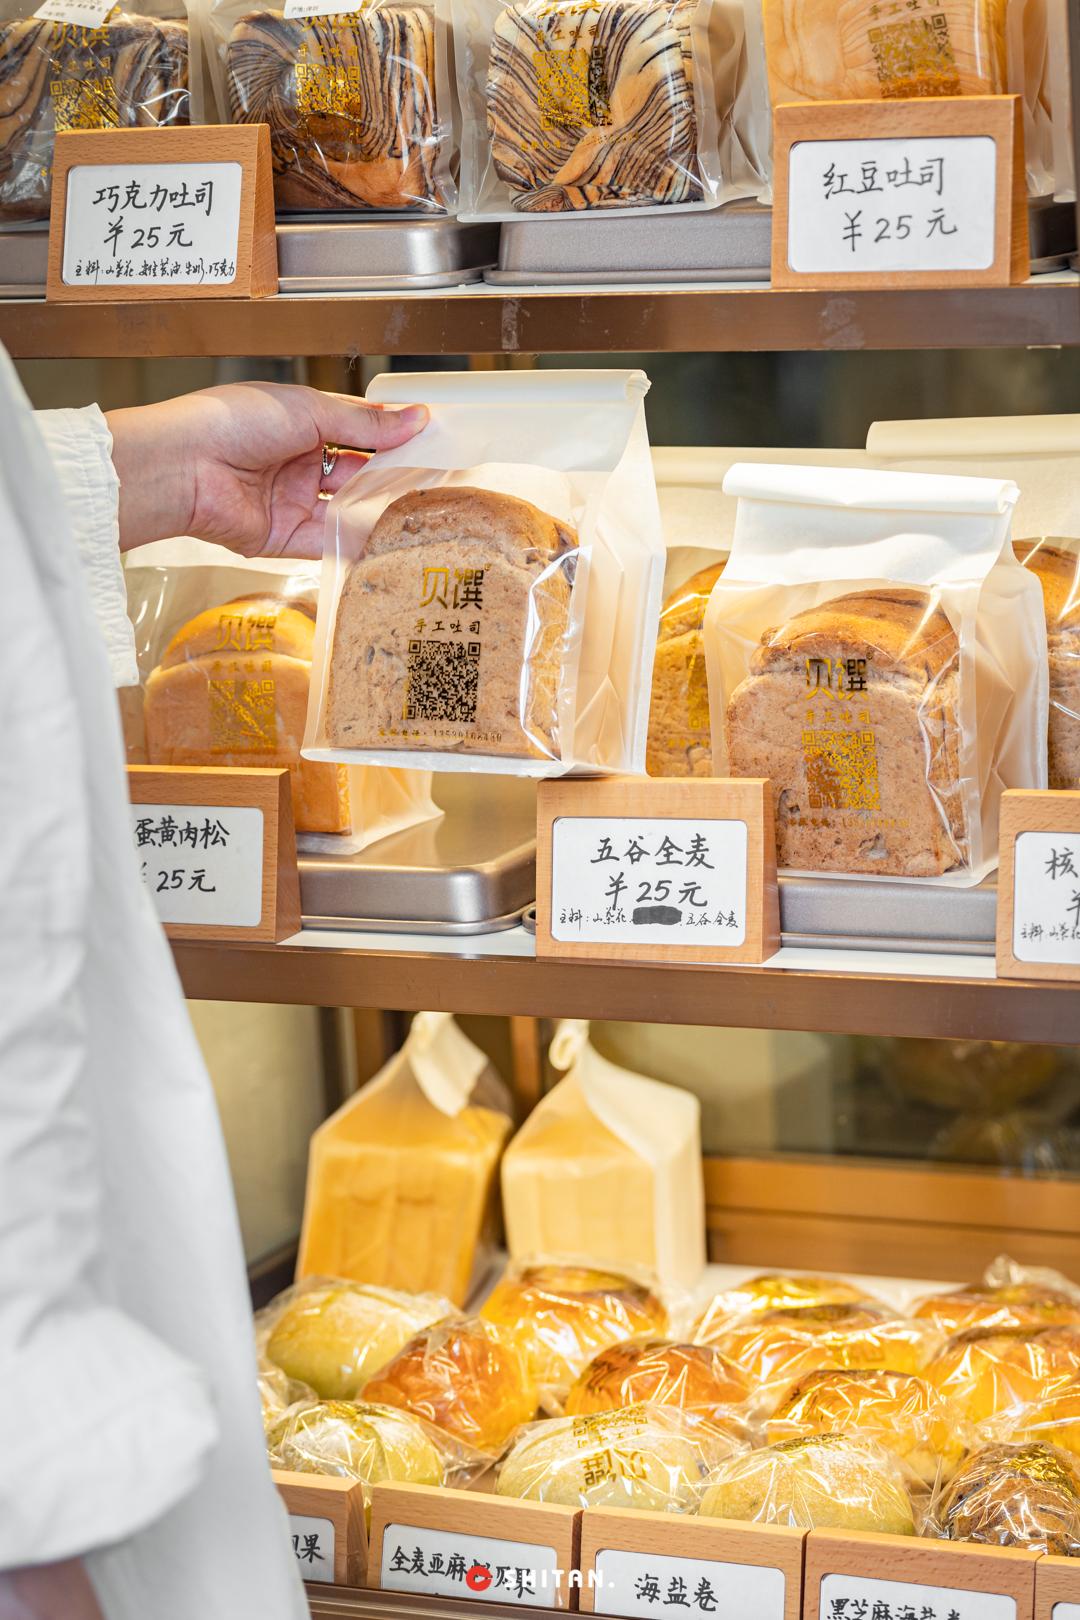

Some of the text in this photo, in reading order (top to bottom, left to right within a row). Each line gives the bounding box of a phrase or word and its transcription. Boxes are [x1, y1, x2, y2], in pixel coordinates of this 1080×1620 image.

[822, 157, 945, 200] 红豆吐司
[93, 180, 214, 217] 巧克力吐司
[413, 618, 481, 636] 手工吐司
[134, 815, 231, 850] 蛋黄肉松
[589, 833, 716, 870] 五谷全麦
[1044, 847, 1079, 881] 核
[140, 861, 217, 893] 25元
[634, 1573, 719, 1612] 海盐卷
